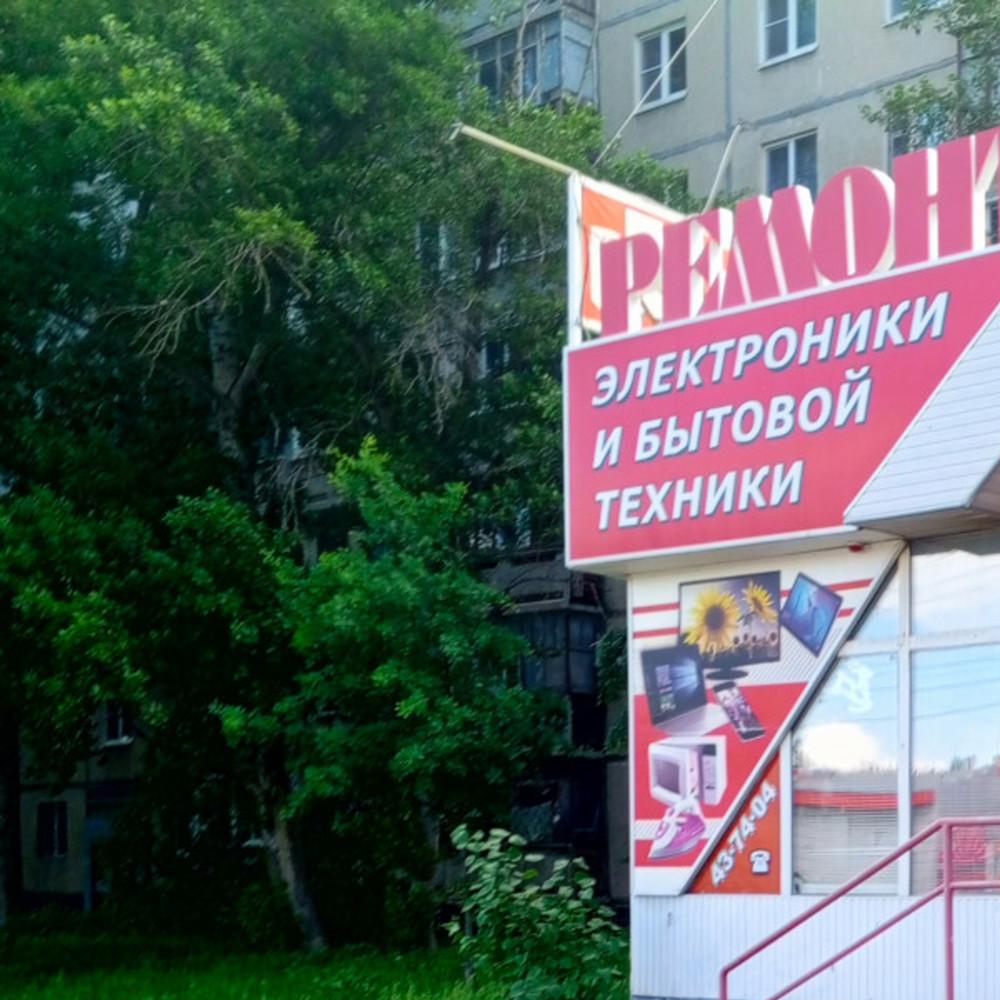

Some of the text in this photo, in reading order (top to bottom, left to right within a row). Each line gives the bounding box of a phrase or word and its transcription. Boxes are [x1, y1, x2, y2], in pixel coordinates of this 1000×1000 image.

[591, 291, 950, 407] ЭЛЕКТРОНИКИ
[591, 366, 873, 470] И БЫТОВОЙ
[595, 460, 805, 530] ТЕХНИКИ
[711, 780, 777, 887] 43-74-04
